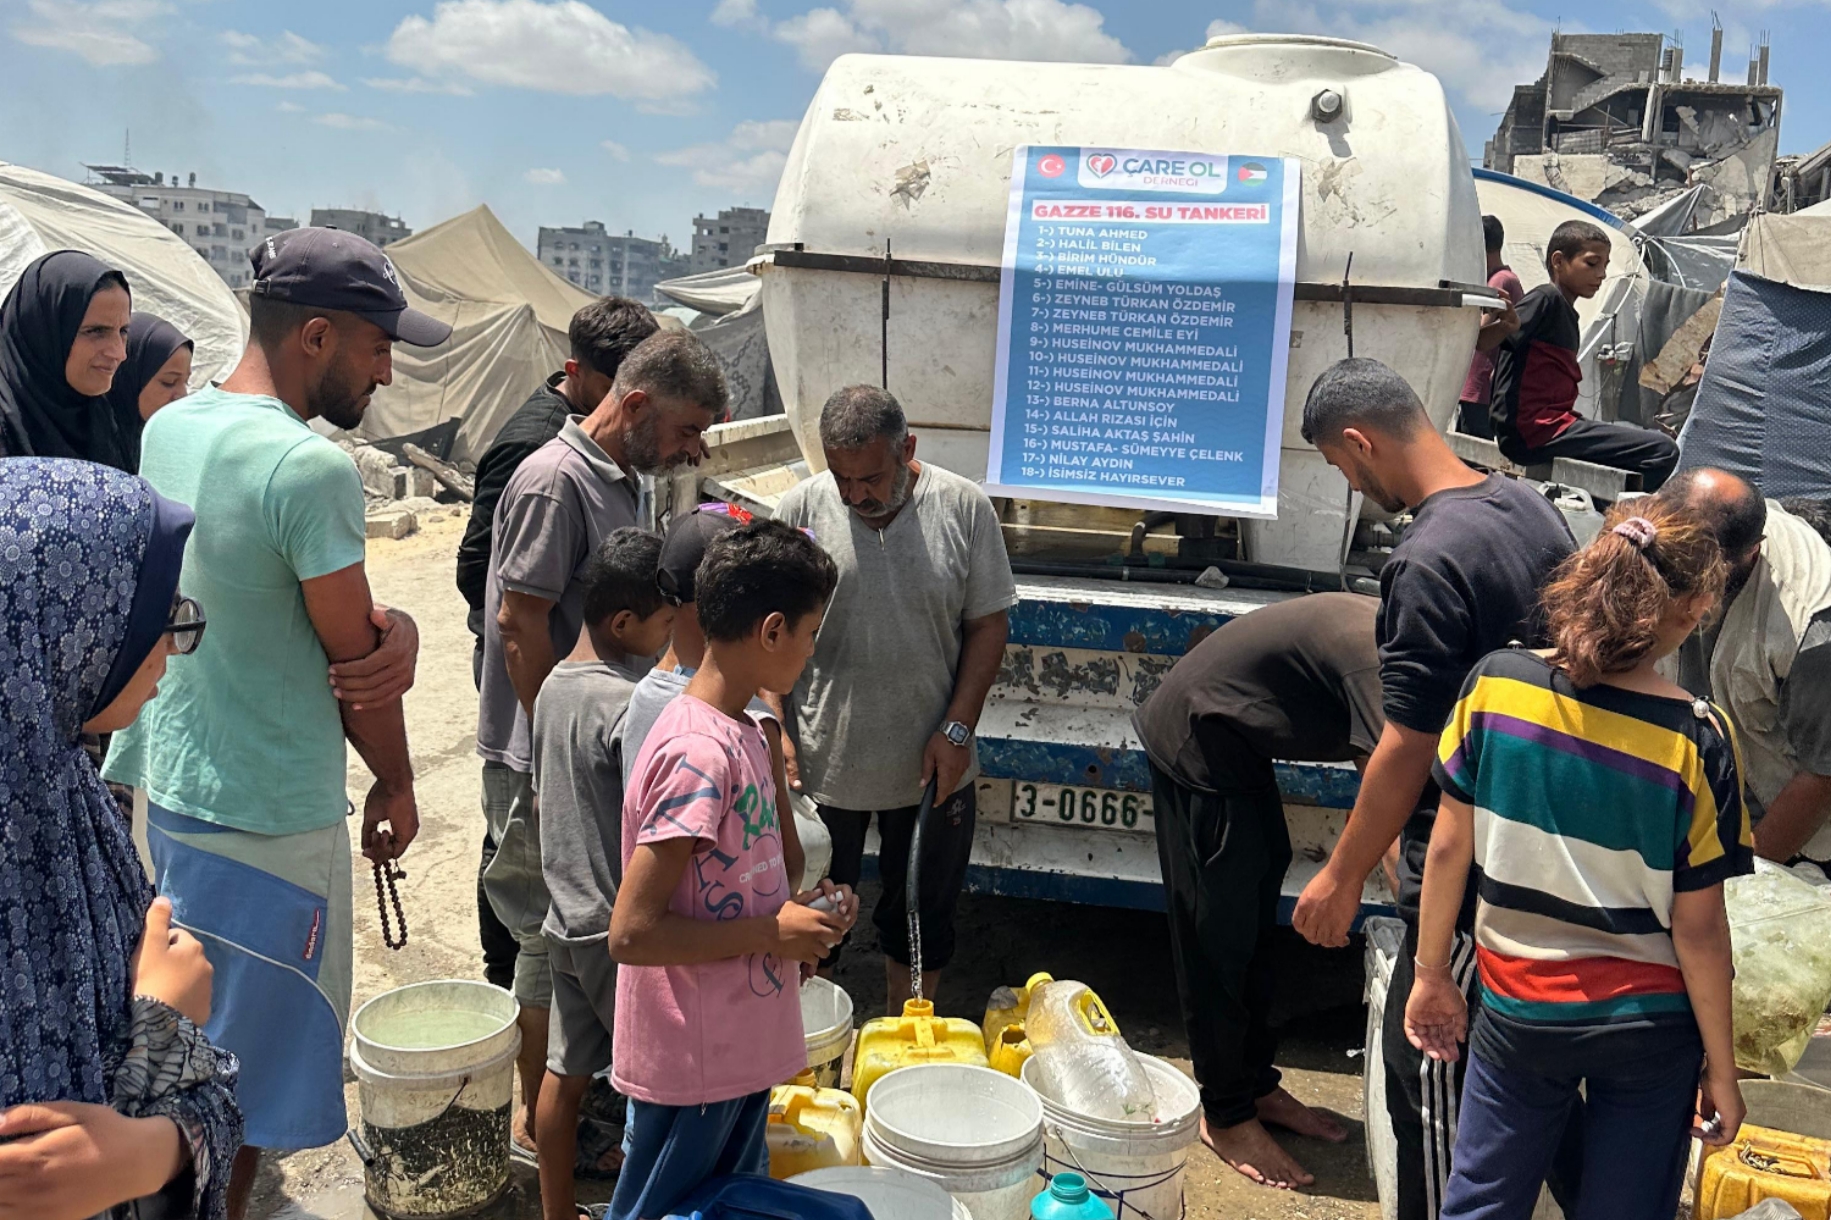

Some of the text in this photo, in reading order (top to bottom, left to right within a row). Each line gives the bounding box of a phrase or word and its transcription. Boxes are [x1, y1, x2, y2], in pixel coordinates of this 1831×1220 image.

[1122, 158, 1221, 178] ÇARE OL
[1034, 204, 1267, 221] GAZZE 116. SU TANKERİ
[1057, 226, 1095, 236] TUNA
[1098, 228, 1148, 239] AHMED
[1058, 238, 1098, 249] HALİL
[1101, 239, 1140, 252] BİLEN
[1057, 251, 1095, 263] BİRİM
[1099, 253, 1157, 266] HÜNDÜR
[1057, 265, 1093, 276] EMEL
[1096, 267, 1124, 278] ULU
[1106, 280, 1162, 294] GÜLSÜM
[1166, 284, 1221, 298] YOLDAŞ
[1054, 293, 1108, 306] ZEYNEB
[1111, 294, 1168, 309] TÜRKAN
[1172, 297, 1235, 312] ÖZDEMİR
[1052, 308, 1106, 320] ZEYNEB
[1109, 309, 1166, 324] TÜRKAN
[1170, 312, 1233, 327] ÖZDEMİR
[1052, 322, 1119, 336] MERHUME
[1123, 325, 1172, 339] CEMİLE
[1176, 328, 1198, 340] EYİ
[1051, 337, 1121, 351] HUSEİNOV
[1124, 341, 1237, 357] MUKHAMMEDALİ
[1057, 352, 1127, 366] HUSEİNOV
[1130, 356, 1243, 372] MUKHAMMEDALİ
[1052, 366, 1122, 380] HUSEİNOV
[1125, 370, 1238, 387] MUKHAMMEDALİ
[1054, 381, 1123, 395] HUSEİNOV
[1126, 385, 1239, 402] MUKHAMMEDALİ
[1053, 396, 1099, 408] BERNA
[1102, 399, 1175, 412] ALTUNSOY
[1052, 410, 1098, 422] ALLAH
[1101, 413, 1145, 425] RIZASI
[1149, 414, 1177, 428] İÇİN
[1051, 424, 1100, 437] SALİHA
[1103, 428, 1149, 442] AKTAŞ
[1152, 430, 1195, 443] ŞAHİN
[1048, 452, 1088, 465] NİLAY
[1090, 456, 1133, 469] AYDIN
[1121, 442, 1185, 458] SÜMEYYE
[1189, 448, 1243, 461] ÇELENK
[1048, 465, 1096, 480] İSİMSİZ
[1099, 471, 1185, 486] HAYIRSEVER
